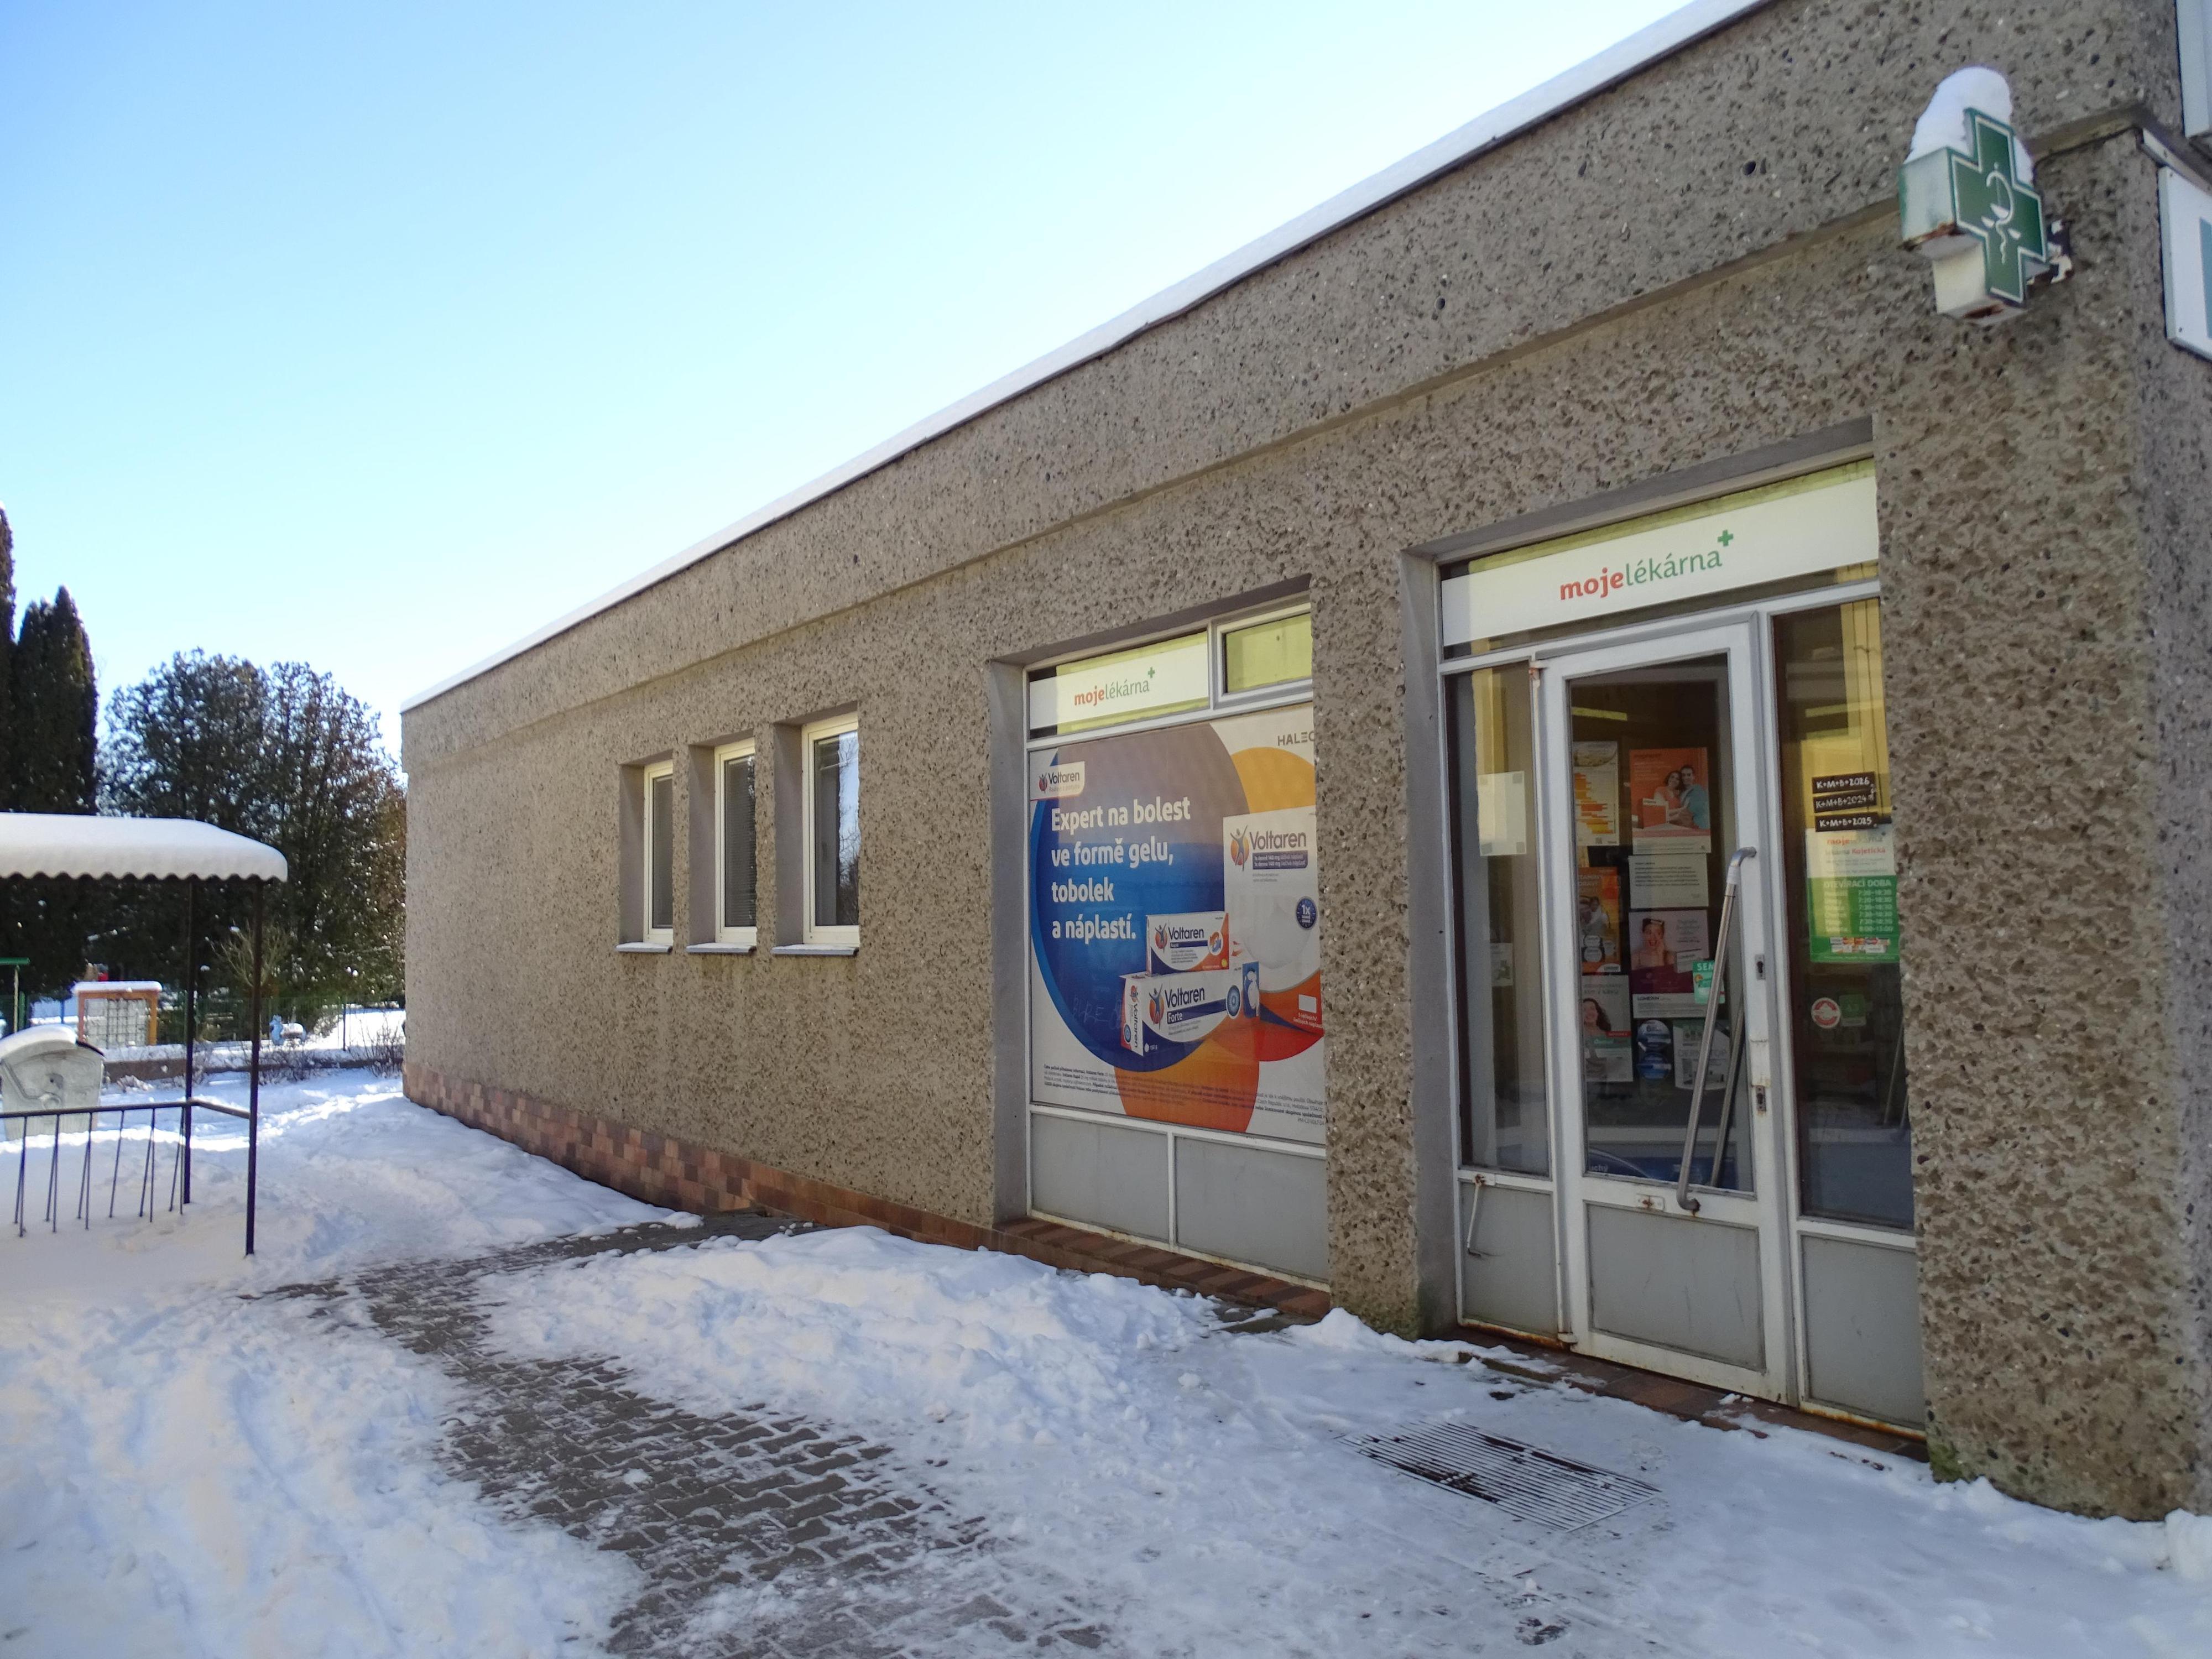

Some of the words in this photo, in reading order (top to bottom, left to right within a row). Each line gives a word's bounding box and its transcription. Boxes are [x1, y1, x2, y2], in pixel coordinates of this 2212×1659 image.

[1048, 772, 1079, 784] Voltaren
[1051, 806, 1103, 834] Expert
[1108, 807, 1128, 826] na
[1133, 796, 1191, 823] bolest
[1249, 830, 1306, 850] Voltaren
[1051, 849, 1070, 867] ve
[1074, 837, 1124, 865] formě
[1128, 836, 1173, 868] gelu,
[1051, 877, 1114, 903] tobolek
[1301, 904, 1310, 915] 1x
[1052, 921, 1061, 938] a
[1065, 913, 1136, 945] náplastí.
[1168, 927, 1204, 940] Voltaren
[1164, 987, 1205, 1008] Voltaren
[1168, 1012, 1183, 1023] Forte
